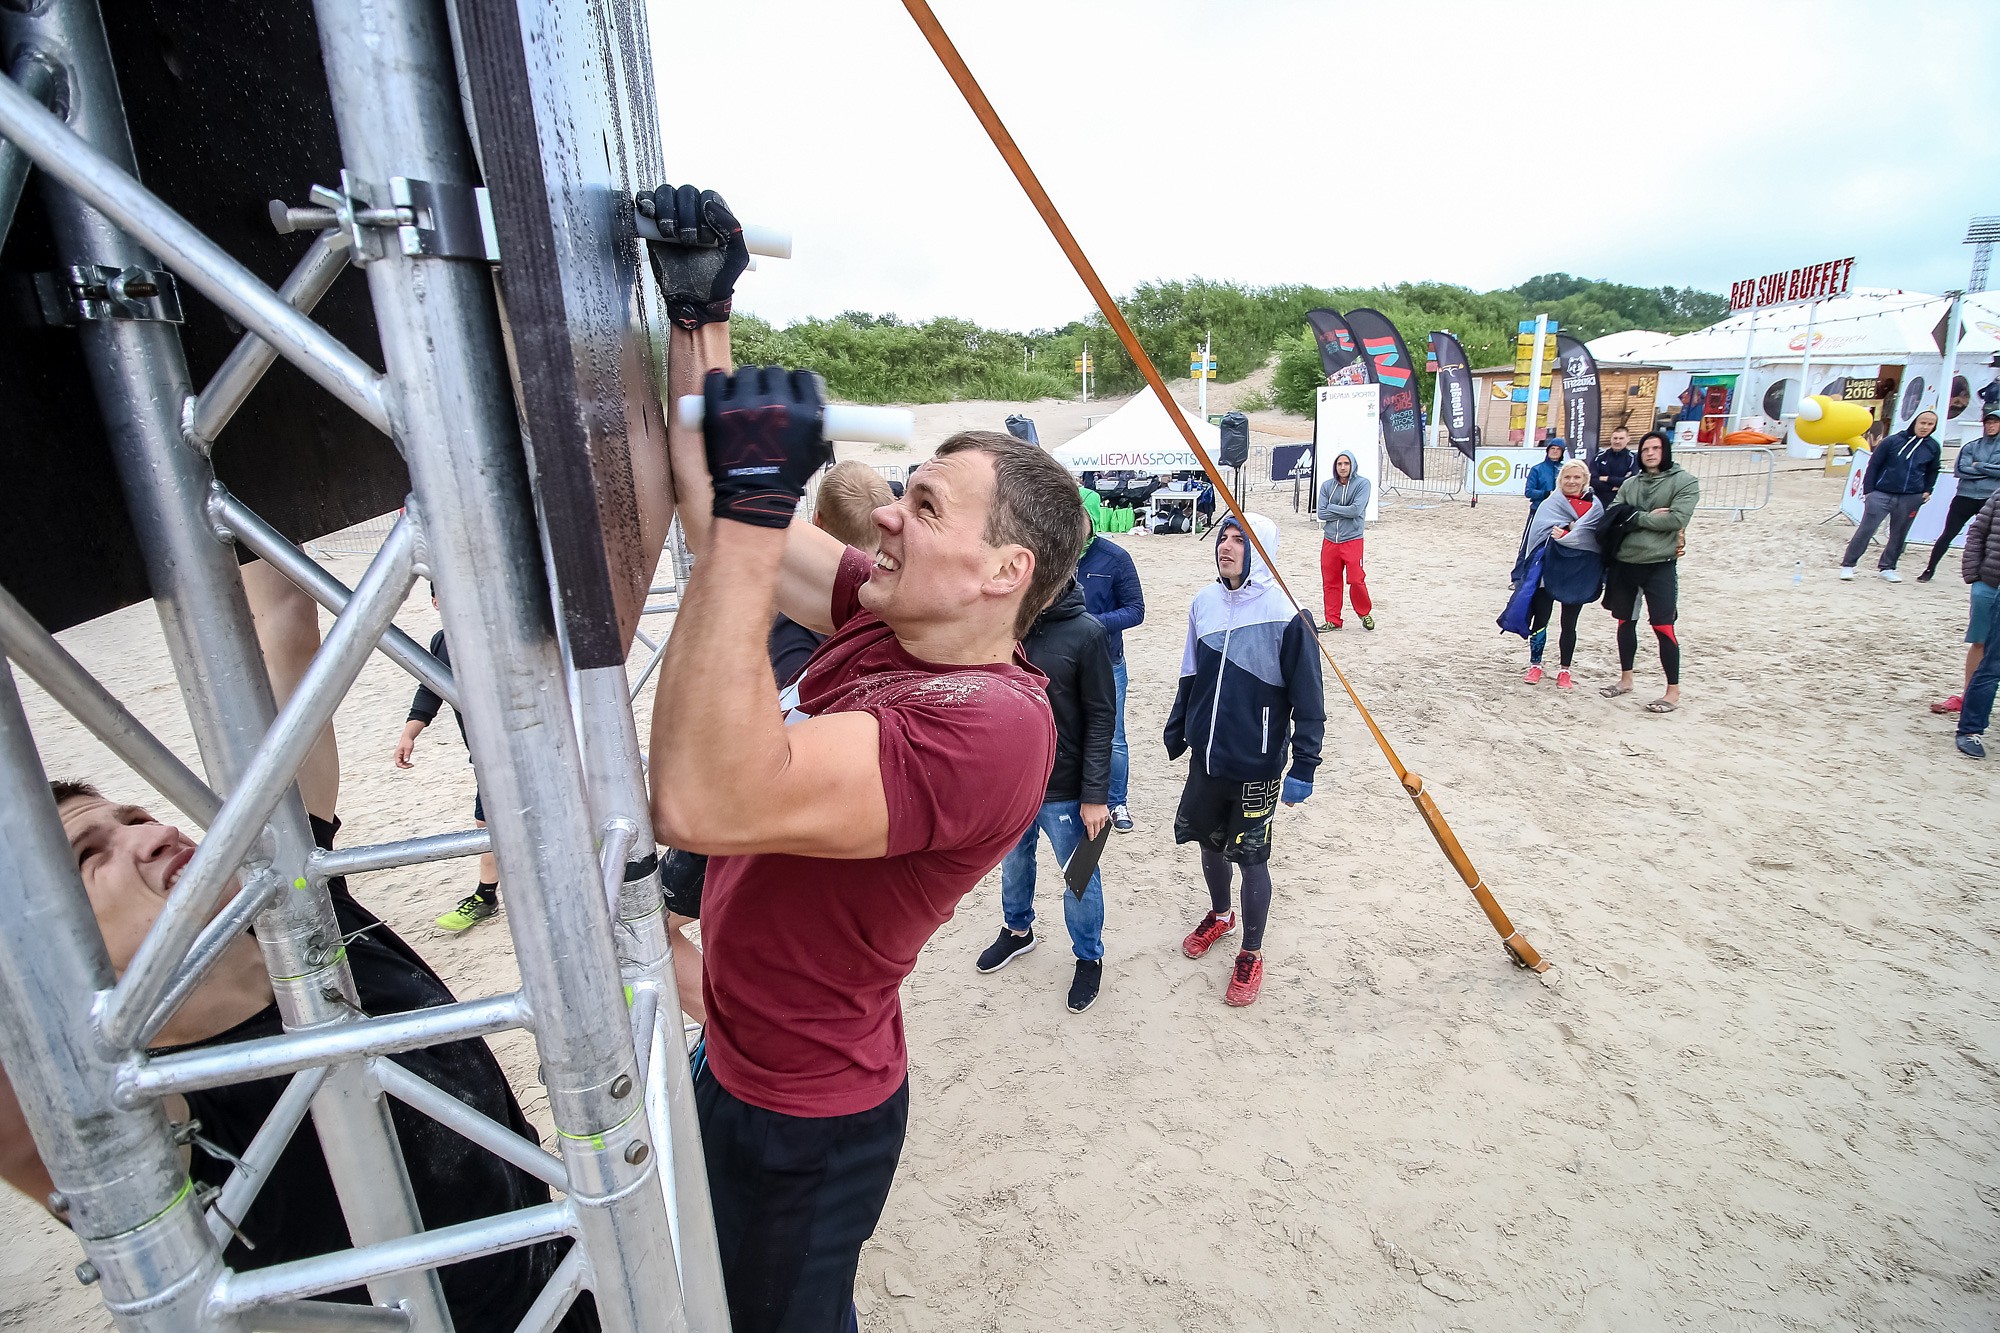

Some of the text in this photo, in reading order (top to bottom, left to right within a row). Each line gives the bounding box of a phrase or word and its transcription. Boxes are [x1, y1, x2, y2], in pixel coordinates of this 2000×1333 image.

[1729, 256, 1855, 311] RED SUN BUFFET
[1844, 387, 1875, 399] 2016
